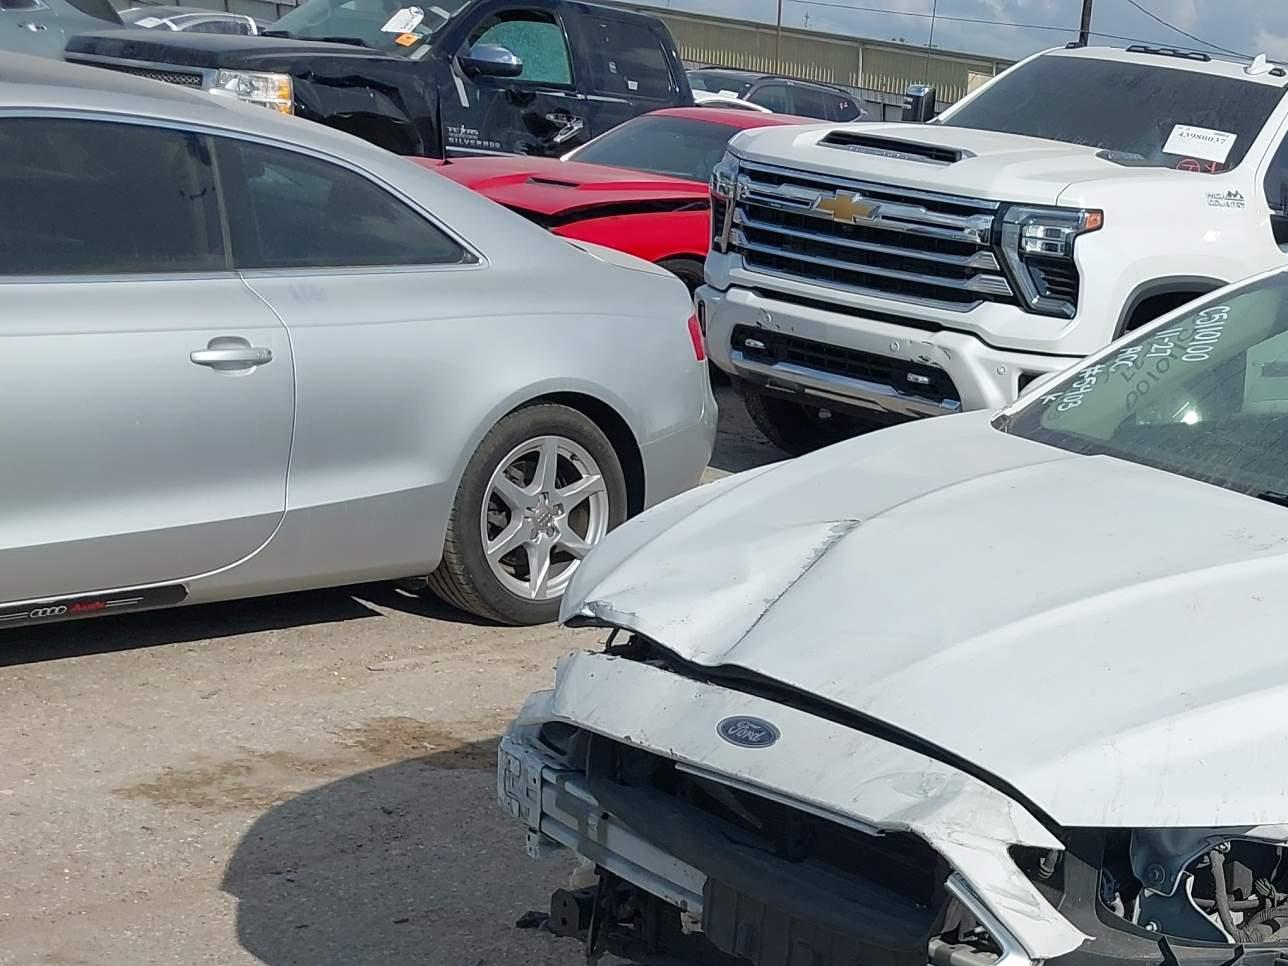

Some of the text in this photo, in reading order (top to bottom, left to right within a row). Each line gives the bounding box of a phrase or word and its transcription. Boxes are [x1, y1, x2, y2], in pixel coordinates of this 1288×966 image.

[448, 137, 500, 149] SILVERADO
[1146, 327, 1184, 358] 11-27
[727, 721, 767, 742] Ford
